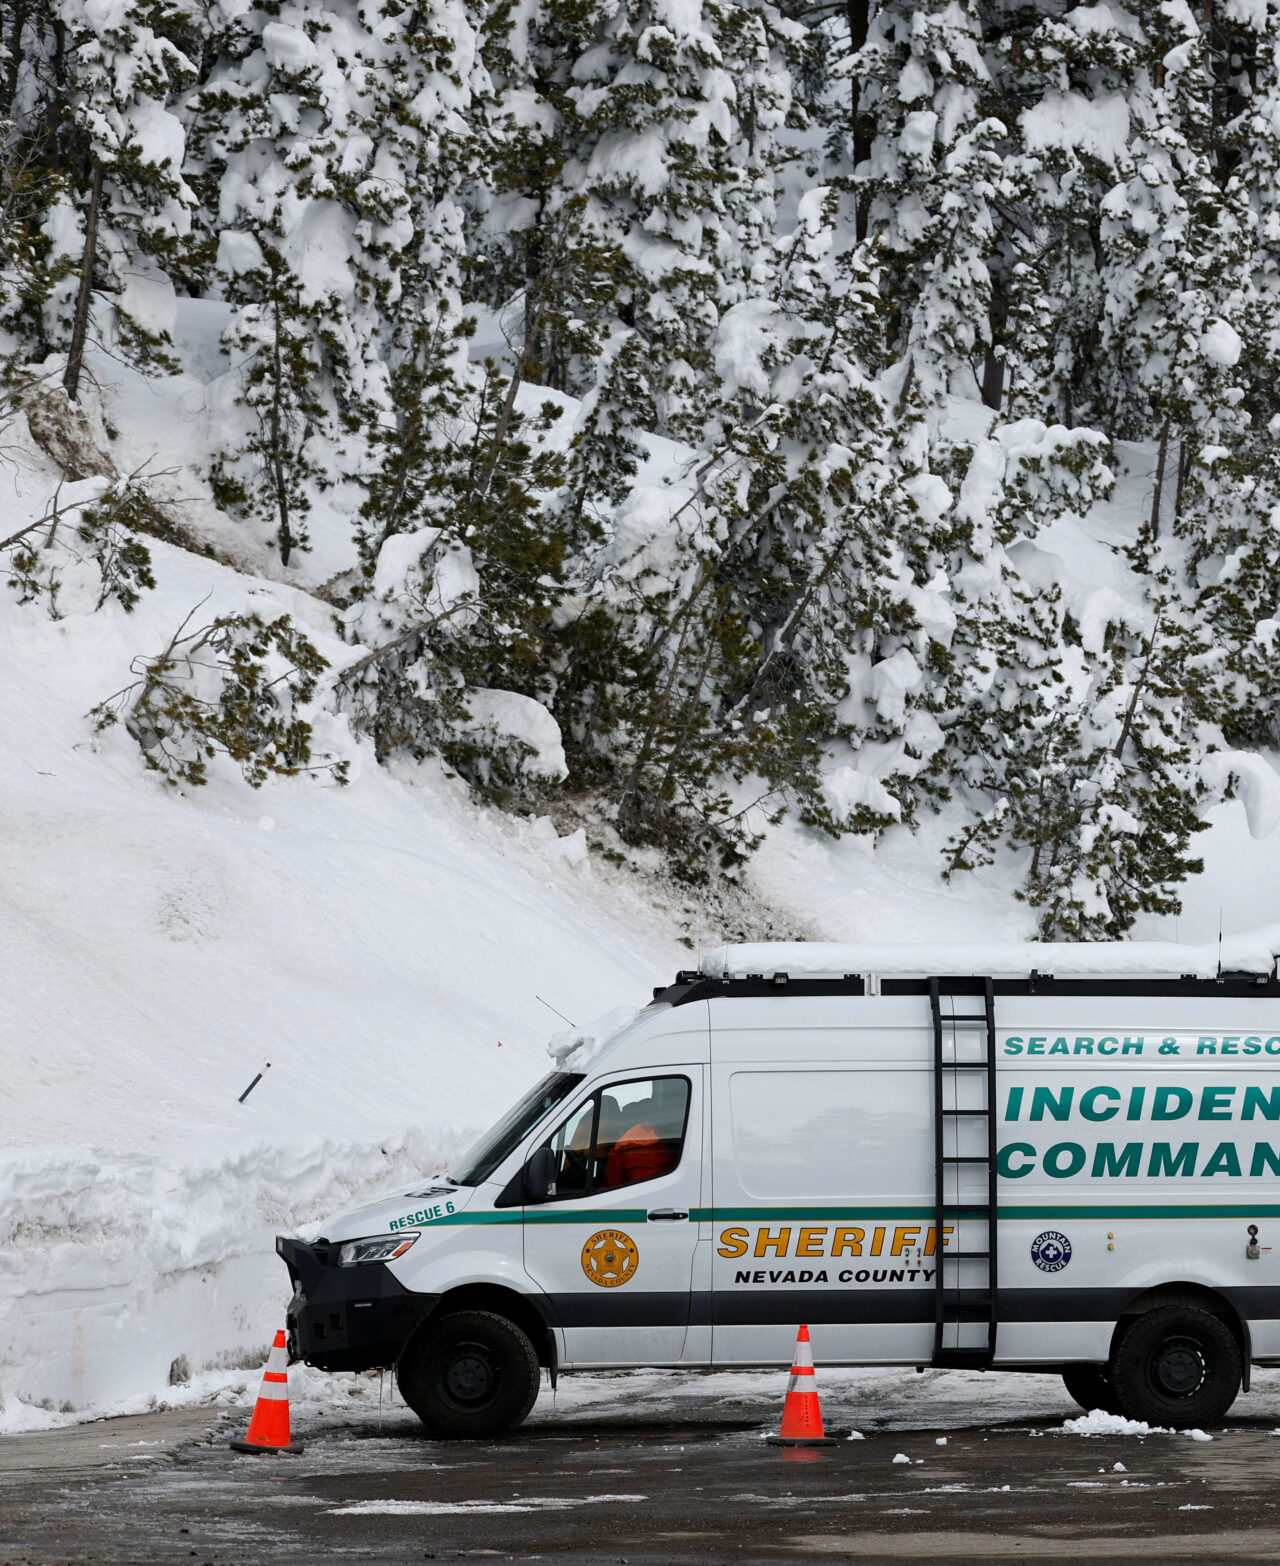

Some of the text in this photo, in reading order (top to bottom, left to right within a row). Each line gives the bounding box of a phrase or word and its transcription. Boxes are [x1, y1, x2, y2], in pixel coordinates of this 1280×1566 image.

[1003, 1036, 1145, 1056] SEARCH
[1157, 1036, 1181, 1056] &
[388, 1201, 456, 1232] RESCUE 6
[590, 1231, 630, 1244] SHERIFF
[716, 1226, 955, 1259] SHERIFF
[1031, 1232, 1071, 1254] MOUNTAIN
[1034, 1258, 1067, 1272] RESCUE
[734, 1268, 937, 1284] NEVADA COUNTY
